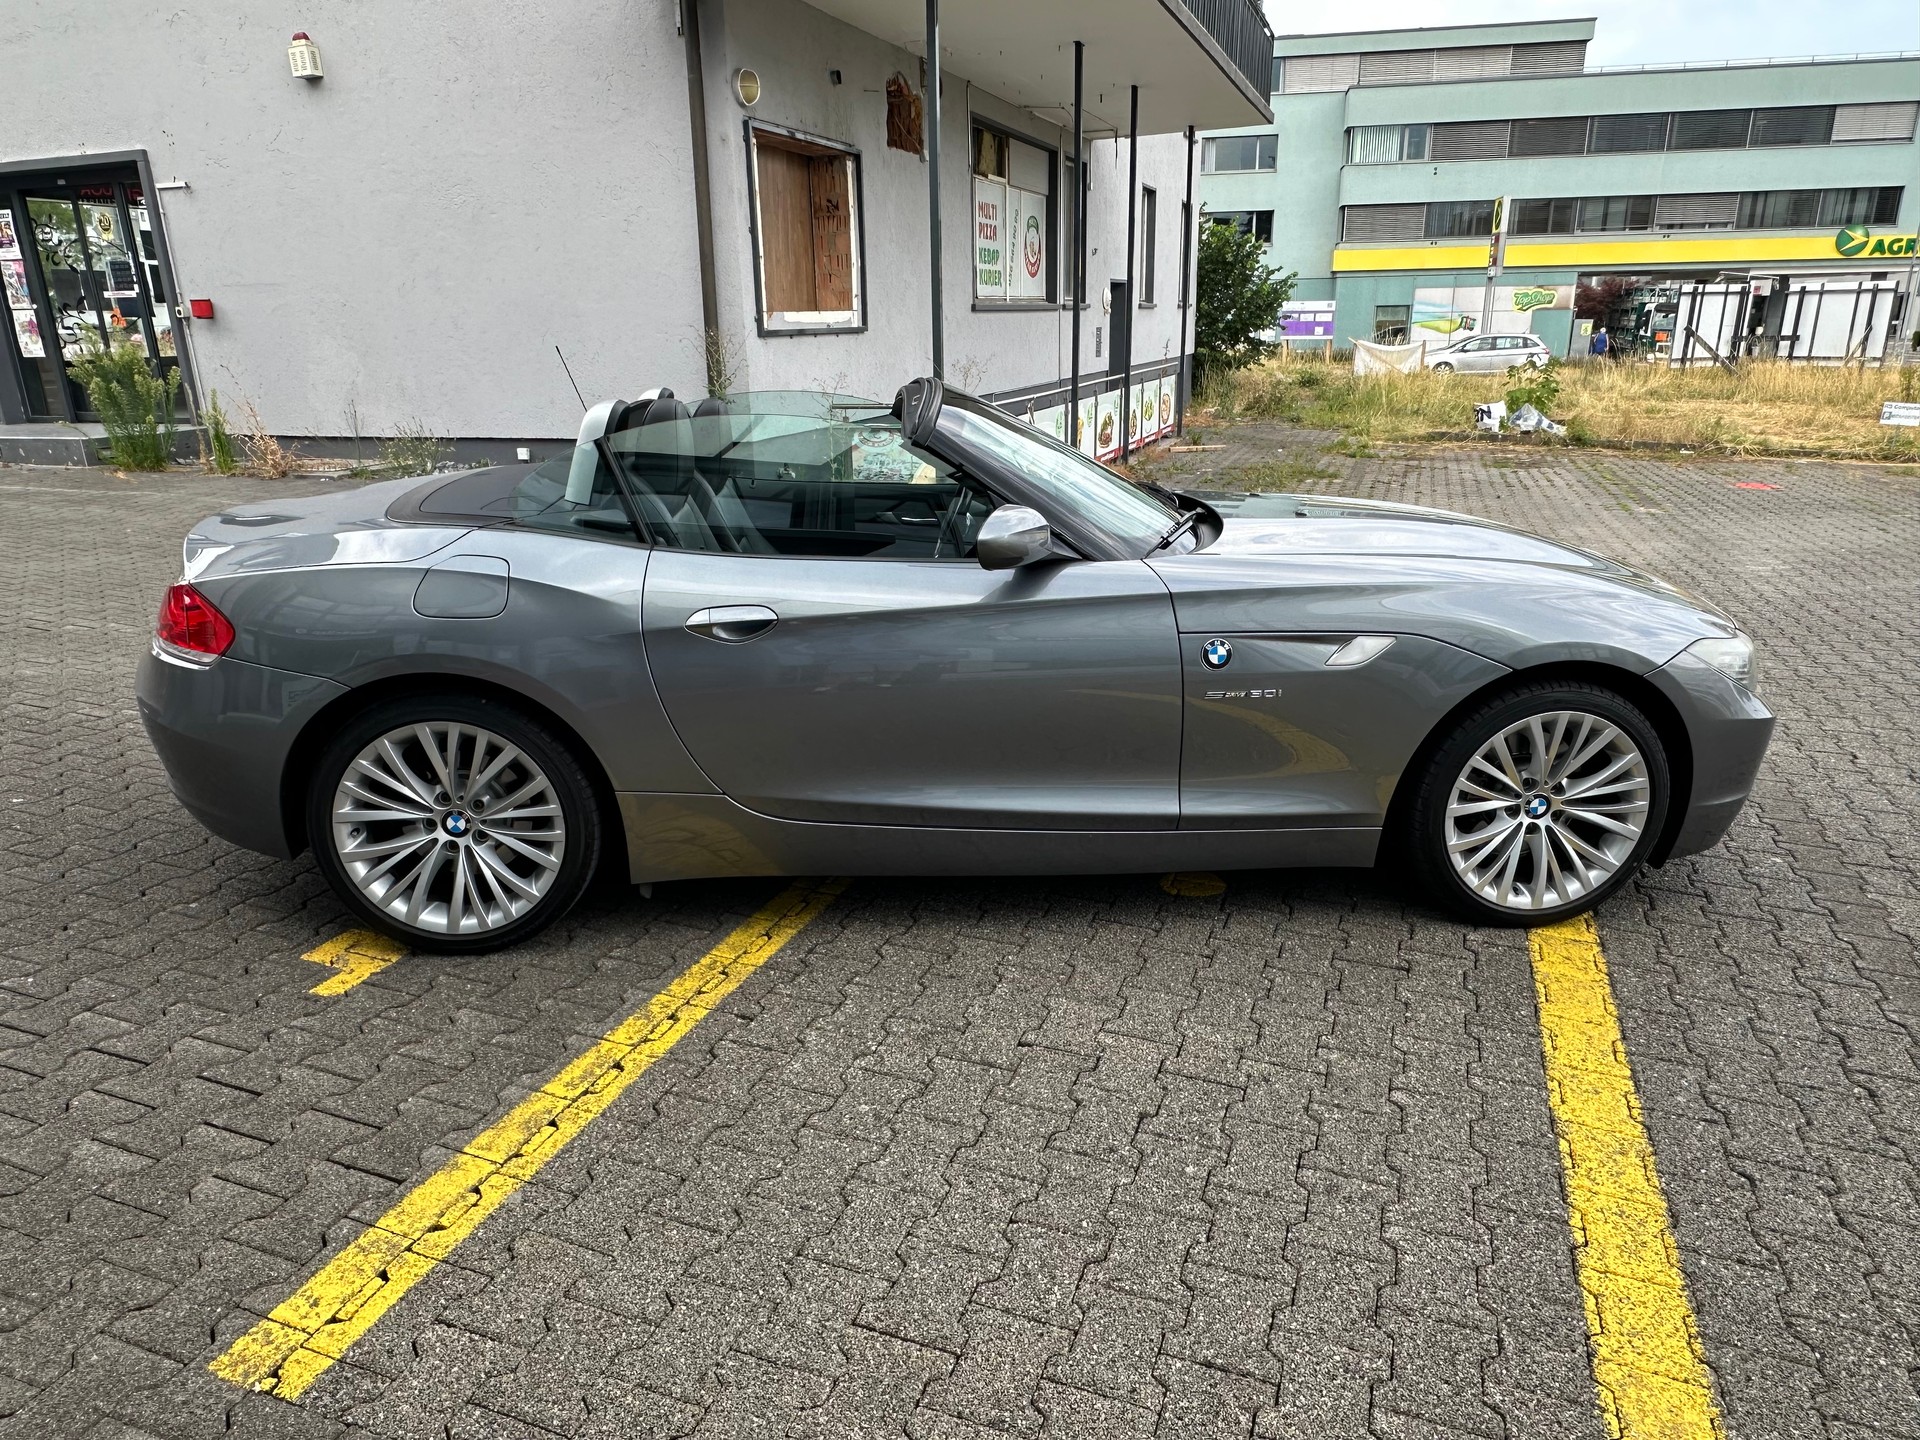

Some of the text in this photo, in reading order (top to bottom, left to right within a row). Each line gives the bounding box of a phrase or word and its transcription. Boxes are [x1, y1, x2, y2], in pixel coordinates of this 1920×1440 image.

[978, 201, 997, 221] MULTI
[979, 222, 997, 242] PIZZA
[978, 247, 1000, 267] KEBAP
[979, 269, 1002, 288] KURIER
